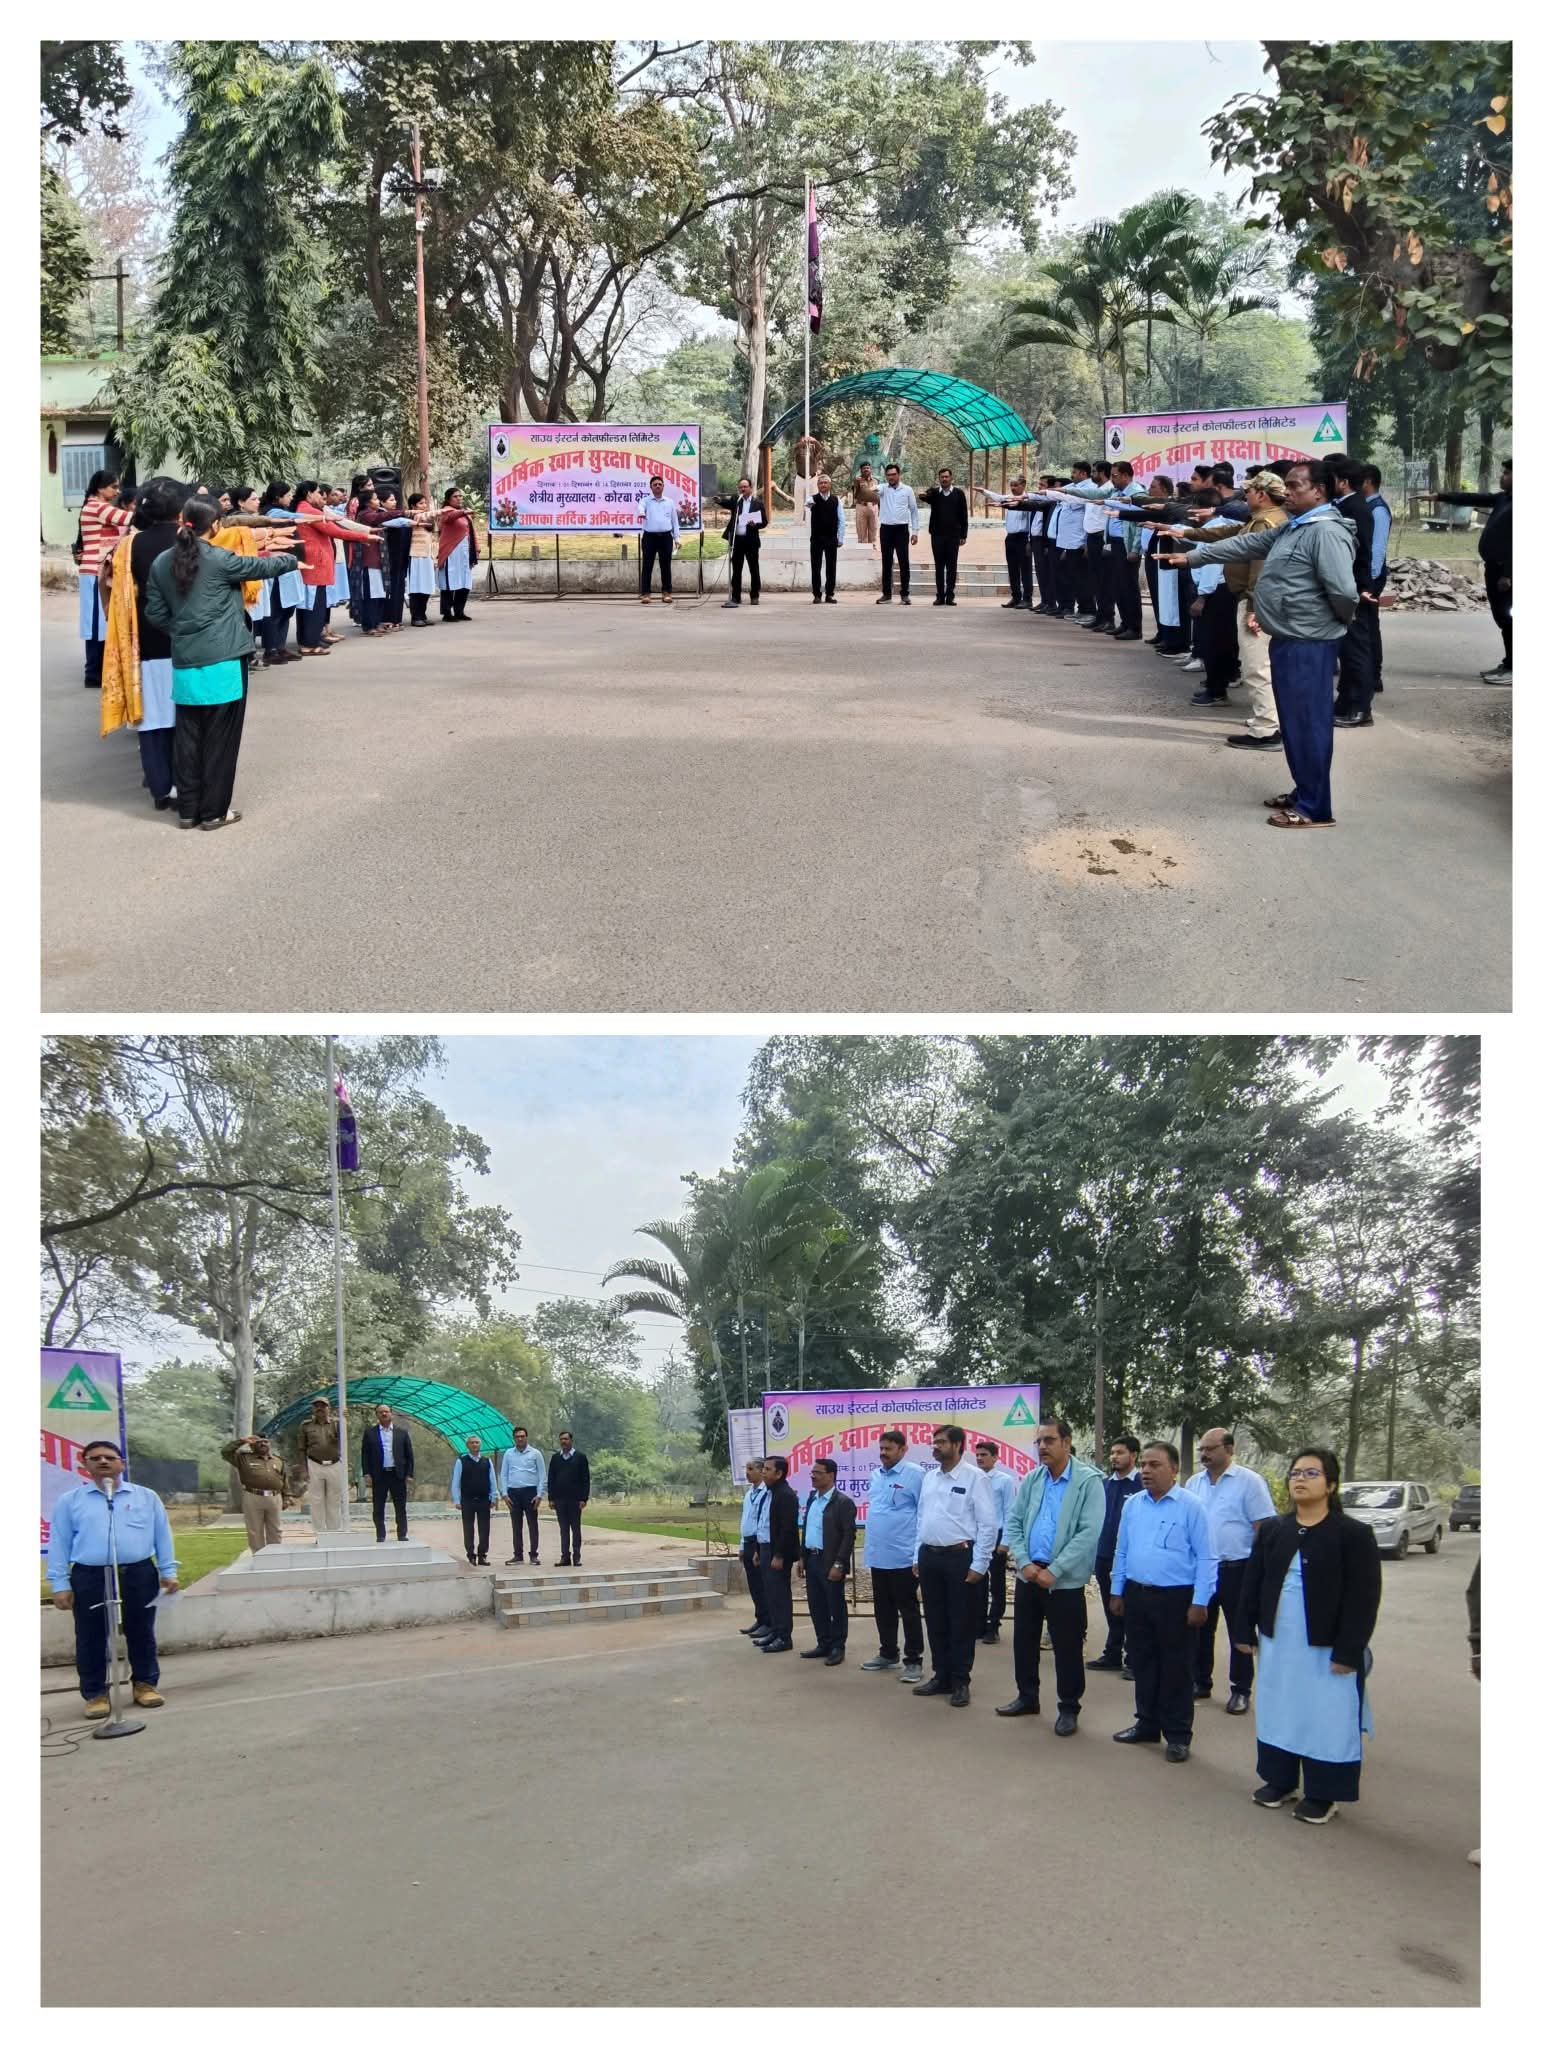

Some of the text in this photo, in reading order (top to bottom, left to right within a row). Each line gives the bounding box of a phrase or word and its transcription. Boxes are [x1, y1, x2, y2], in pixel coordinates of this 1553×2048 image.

[1147, 424, 1170, 434] साउथ
[1258, 416, 1296, 429] लिमिटेड
[530, 433, 553, 442] साउथ
[629, 431, 660, 443] लिमिटेड
[1166, 441, 1206, 465] खान
[496, 458, 545, 496] वार्षिक
[548, 450, 585, 472] खान
[588, 449, 632, 473] सुरक्षा
[529, 490, 553, 503] क्षेत्रीय
[556, 492, 596, 507] मुख्यालय
[604, 490, 632, 503] कोरबा
[519, 512, 553, 525] आपका
[555, 510, 586, 525] हार्दिक
[590, 510, 633, 525] अभिनंदन
[816, 1397, 986, 1415] साउथ ईस्टर्न कोलफील्डस लिमिटेड
